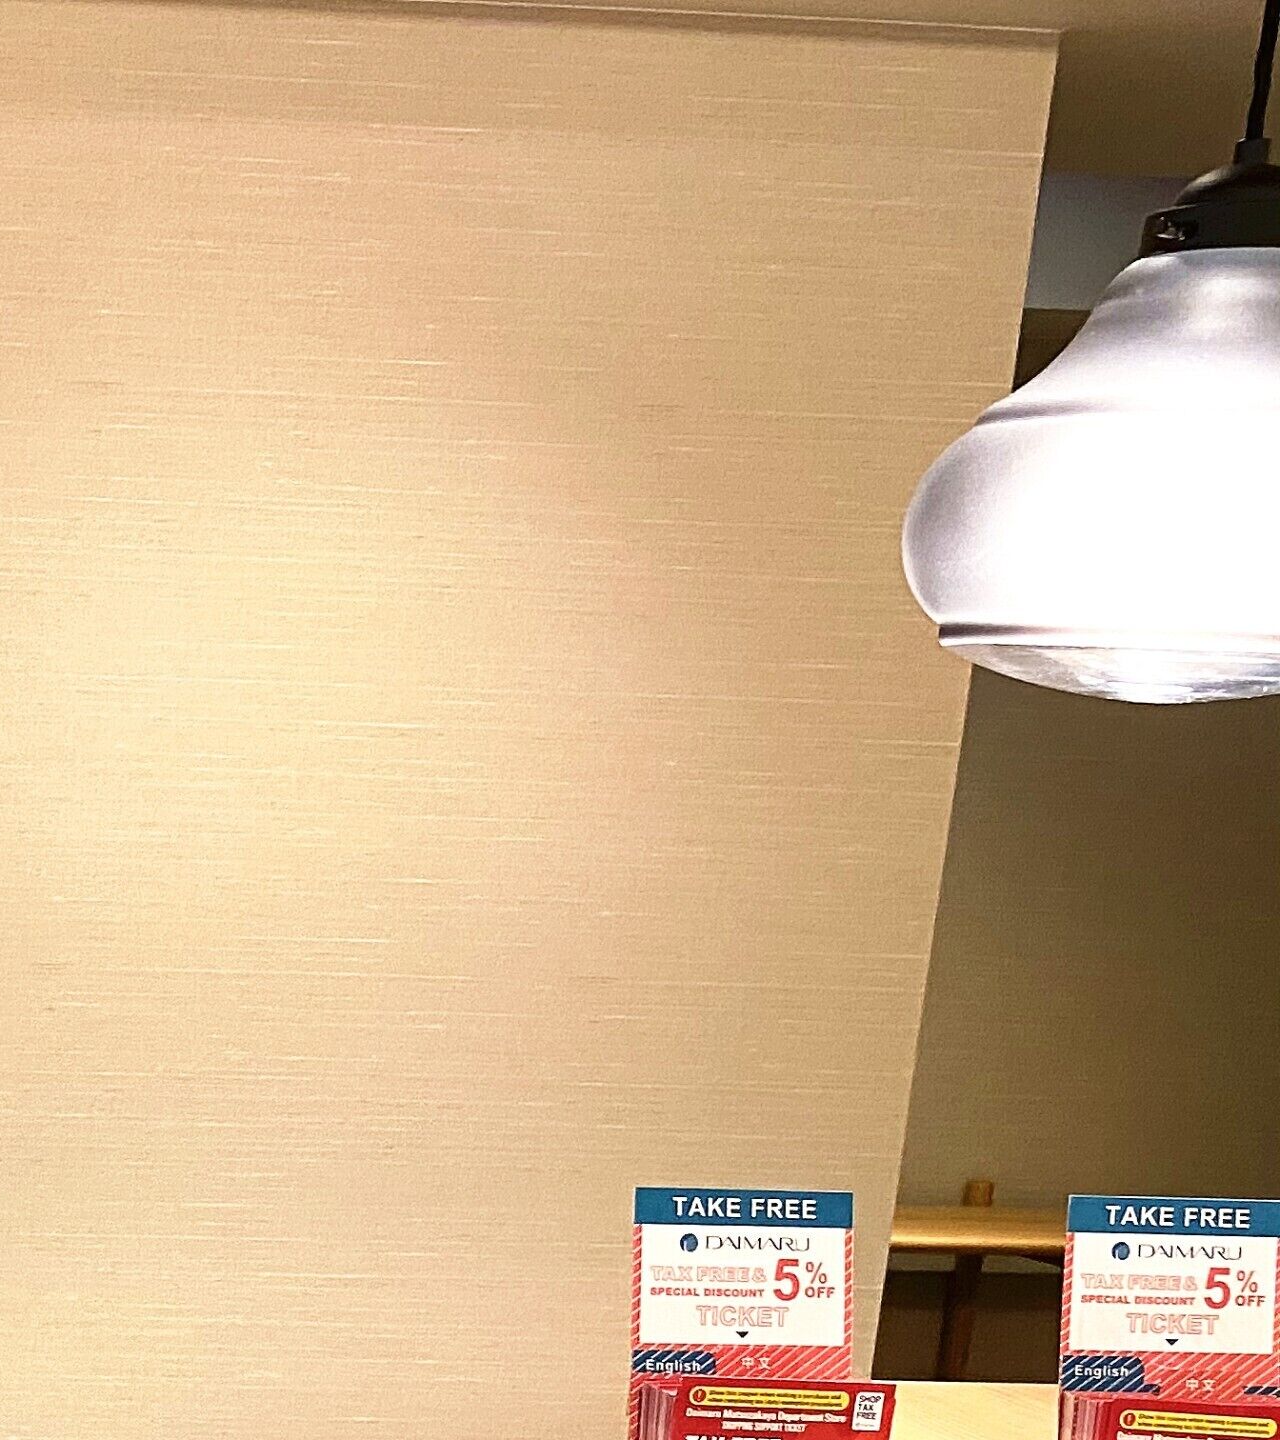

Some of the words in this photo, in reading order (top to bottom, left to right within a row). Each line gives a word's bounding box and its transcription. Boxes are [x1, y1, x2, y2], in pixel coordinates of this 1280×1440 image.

[672, 1196, 742, 1218] TAKE
[750, 1198, 817, 1220] FREE
[1106, 1205, 1175, 1227] TAKE
[1184, 1207, 1251, 1229] FREE
[705, 1234, 811, 1252] DAIMARU
[1138, 1244, 1242, 1261] DAIMARU
[650, 1265, 692, 1282] TAX
[696, 1265, 748, 1283] FREE
[751, 1267, 768, 1283] &
[1081, 1273, 1123, 1289] TAX
[1127, 1274, 1180, 1291] FREE
[1183, 1276, 1197, 1291] &
[649, 1286, 700, 1298] SPECIAL
[703, 1287, 765, 1299] DISCOUNT
[804, 1286, 836, 1299] OFF
[1081, 1295, 1130, 1304] SPECIAL
[1134, 1295, 1196, 1306] DISCOUNT
[1235, 1295, 1266, 1307] OFF
[696, 1304, 790, 1328] TICKET
[1126, 1312, 1220, 1335] TICKET
[645, 1357, 702, 1376] English
[741, 1354, 773, 1371] 中文
[1074, 1364, 1130, 1380] English
[1186, 1379, 1217, 1392] 中文
[855, 1412, 877, 1420] FREE
[856, 1404, 874, 1413] TAX
